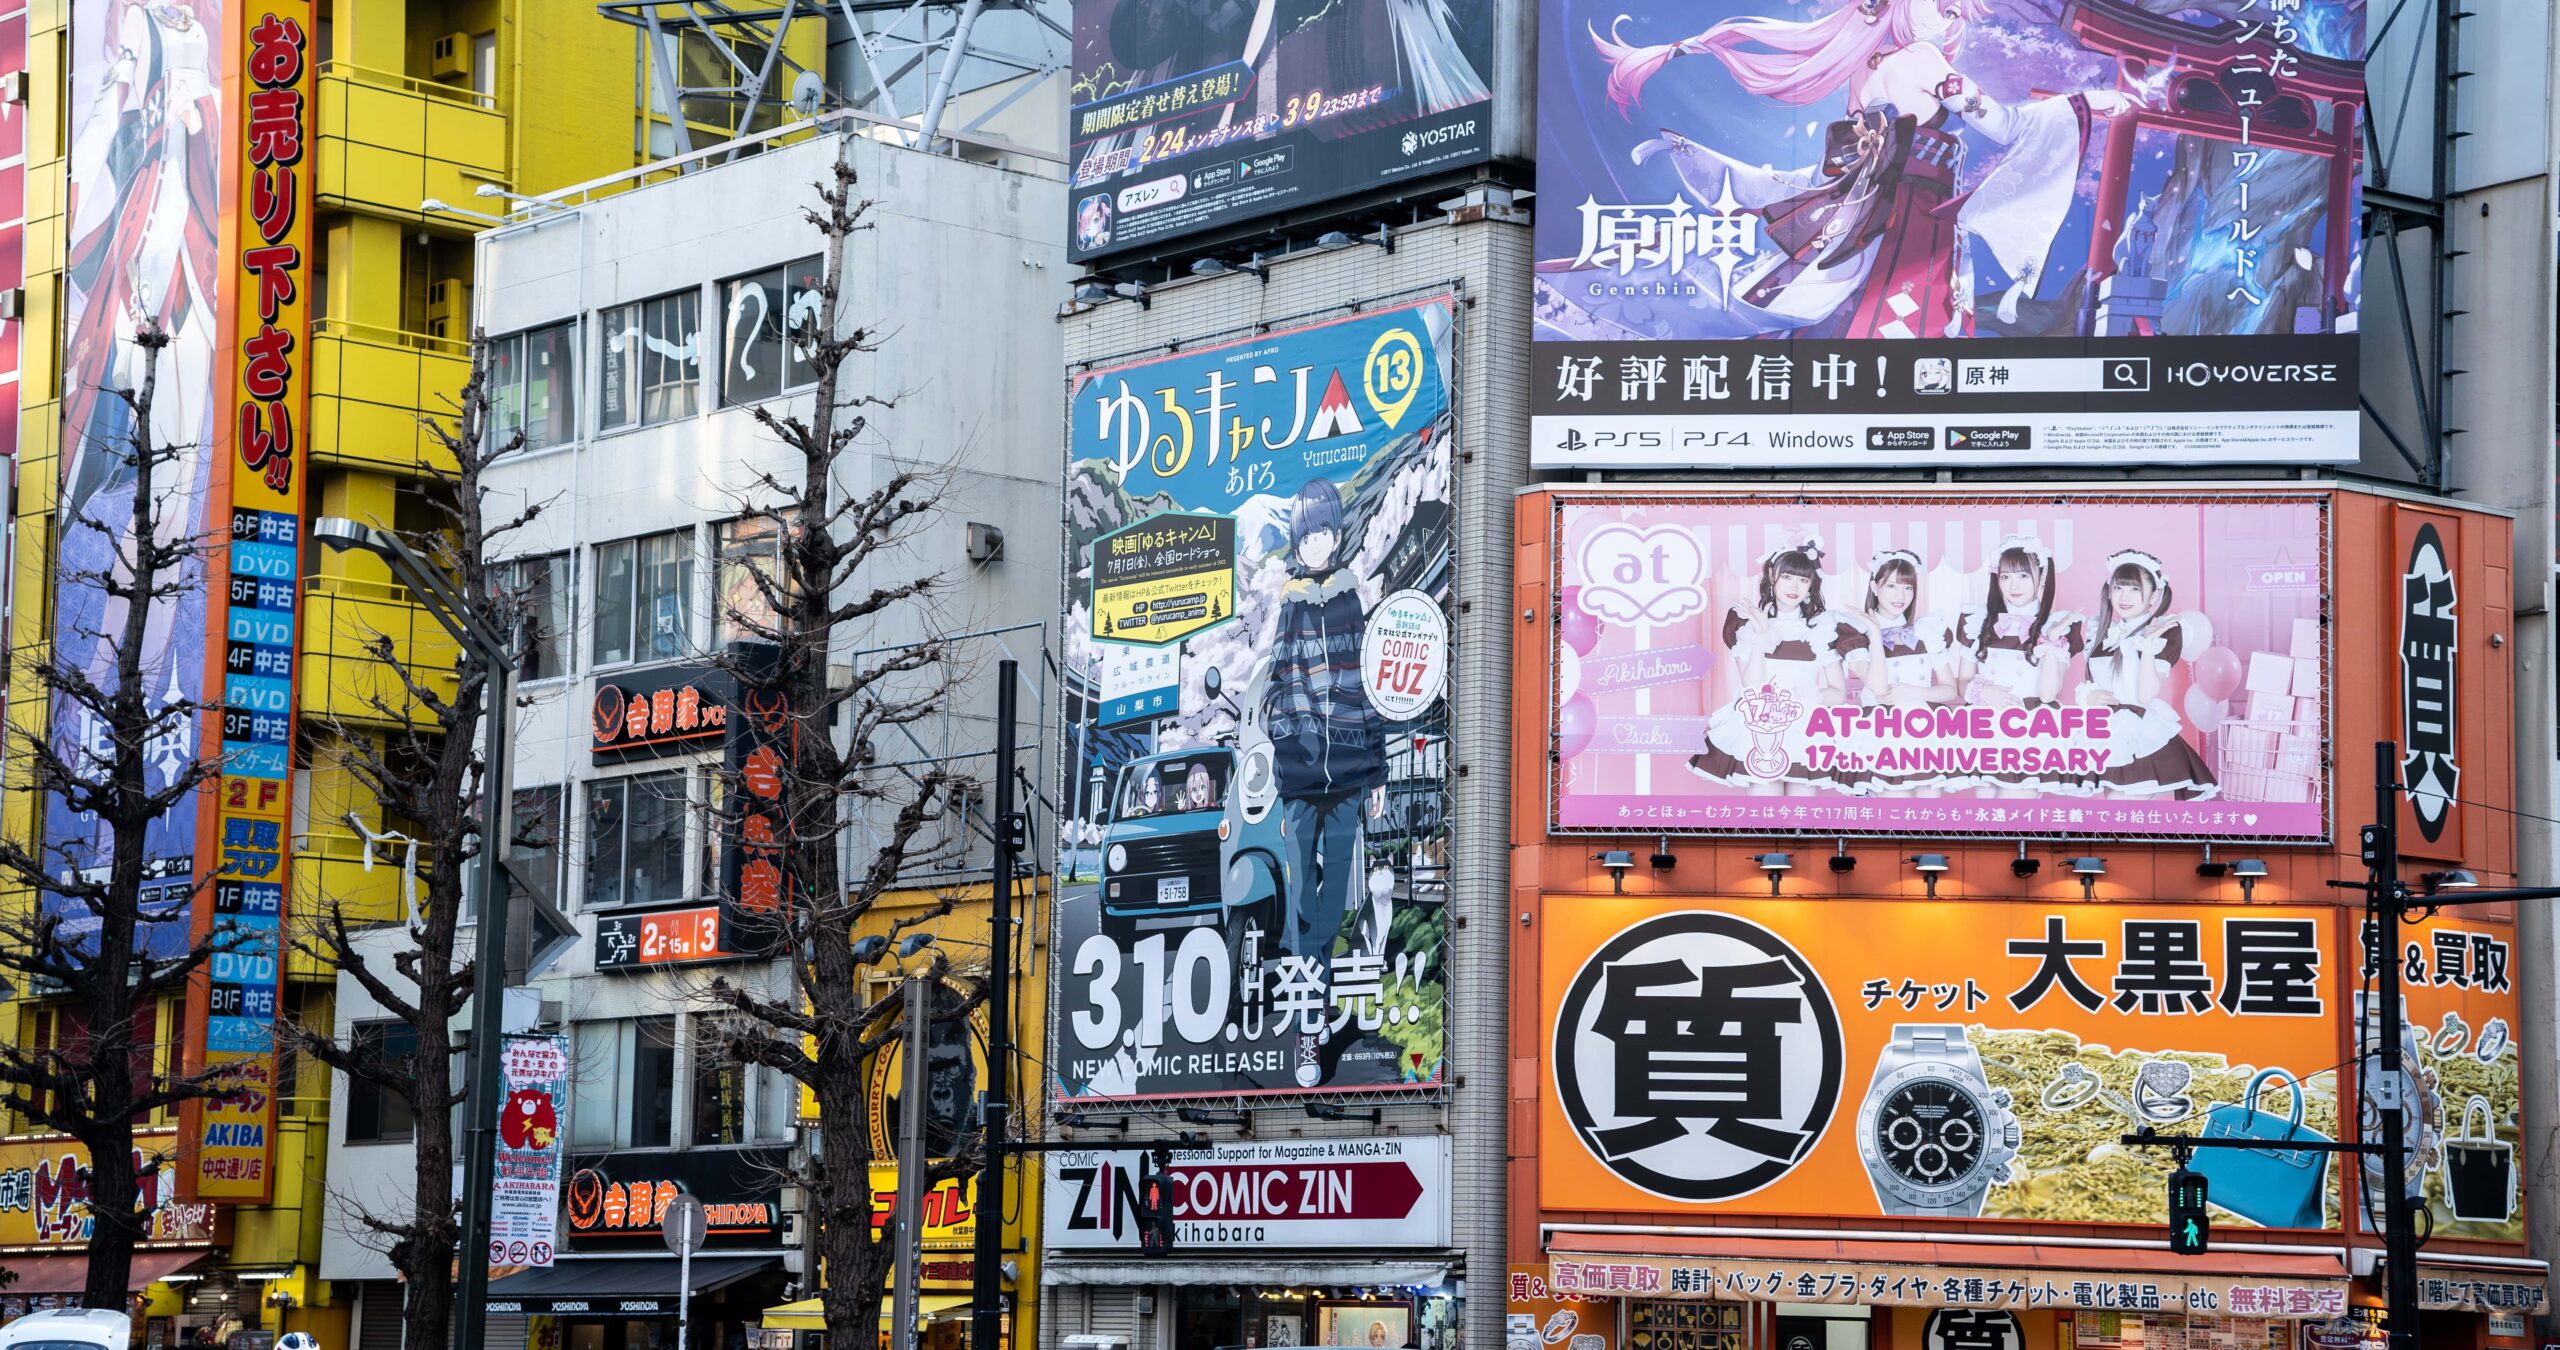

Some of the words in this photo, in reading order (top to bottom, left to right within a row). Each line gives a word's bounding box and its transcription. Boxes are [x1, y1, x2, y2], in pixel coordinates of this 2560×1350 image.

[1080, 72, 1240, 135] 期間限定着せ替え登場!
[1079, 147, 1132, 181] 登場期間
[1138, 126, 1186, 164] 2/24
[1184, 113, 1267, 152] メンテナンス後
[1282, 91, 1322, 128] 3/9
[1320, 85, 1382, 117] 23:59まで
[1419, 120, 1475, 147] YOSTAR
[1254, 156, 1273, 168] Google
[1273, 153, 1286, 163] Play
[1203, 171, 1216, 182] App
[1216, 167, 1231, 178] Store
[1125, 187, 1159, 207] アズレン
[1570, 170, 1758, 311] 原神
[1589, 283, 1697, 296] Genshin
[1377, 350, 1410, 394] 13
[1556, 354, 1888, 402] 好評配信中!
[1965, 366, 2010, 386] 原神
[2168, 362, 2337, 386] HOYOVERSE
[1595, 432, 1662, 447] PS5
[1684, 432, 1752, 447] PS4
[1769, 430, 1854, 449] Windows
[1887, 431, 1905, 440] App
[1906, 431, 1929, 440] Store
[1970, 431, 2000, 441] Google
[2002, 431, 2019, 441] Play
[1303, 442, 1367, 468] Yurucamp
[233, 514, 258, 535] 6F
[260, 515, 296, 542] 中古
[238, 555, 290, 576] DVD
[1613, 545, 1670, 584] at
[2261, 571, 2306, 584] OPEN
[232, 580, 256, 602] 5F
[259, 583, 294, 608] 中古
[1136, 604, 1145, 613] HP
[234, 619, 288, 643] DVD
[1120, 617, 1147, 628] TWITTER
[228, 648, 252, 668] 4F
[255, 649, 291, 674] 中古
[1382, 640, 1430, 661] COMIC
[1376, 659, 1428, 696] FUZ
[1598, 657, 1692, 686] Akihabara
[230, 685, 286, 710] DVD
[2399, 568, 2461, 808] 質
[626, 685, 700, 739] 吉野家
[1117, 696, 1163, 716] 山梨市
[225, 714, 250, 735] 3F
[253, 716, 288, 740] 中古
[1805, 707, 1995, 739] AT-HOME
[1999, 708, 2112, 739] CAFE
[1805, 745, 1864, 771] 17th
[1875, 746, 2112, 773] ANNIVERSARY
[223, 817, 281, 850] 買取
[223, 849, 281, 878] フロア
[218, 887, 240, 907] 1F
[244, 887, 279, 911] 中古
[216, 953, 273, 980] DVD
[2006, 916, 2324, 1017] 大黒屋
[211, 989, 240, 1010] B1F
[245, 989, 273, 1013] 中古
[1862, 979, 1989, 1013] チケット
[512, 1048, 558, 1060] みんなで協力
[1072, 1055, 1121, 1080] NEW
[1122, 1054, 1182, 1078] COMIC
[1188, 1050, 1285, 1075] RELEASE!
[1588, 955, 1814, 1164] 質
[204, 1123, 263, 1147] AKIBA
[498, 1152, 556, 1166] Welcome!
[1059, 1151, 1099, 1168] COMIC
[1217, 1146, 1255, 1162] Support
[1258, 1145, 1272, 1159] for
[1274, 1143, 1325, 1161] Magazine
[1328, 1142, 1336, 1157] &
[1338, 1141, 1402, 1157] MANGA-ZIN
[202, 1157, 262, 1180] 中央通り店
[503, 1181, 555, 1191] AKIHABARA
[1172, 1170, 1289, 1216] COMIC
[1298, 1169, 1354, 1214] ZIN
[603, 1180, 678, 1228] 吉野家
[704, 1203, 768, 1226] SHINOYA
[39, 1214, 83, 1243] ムーラン
[1173, 1222, 1265, 1242] kihabara
[1553, 1261, 1661, 1292] 高価買取
[2230, 1285, 2345, 1315] 無料査定
[2418, 1278, 2545, 1310] 1階にて高価買取中
[485, 1302, 522, 1312] YOSHINOYA
[552, 1301, 590, 1312] YOSHINOYA
[620, 1301, 659, 1312] YOSHINOYA
